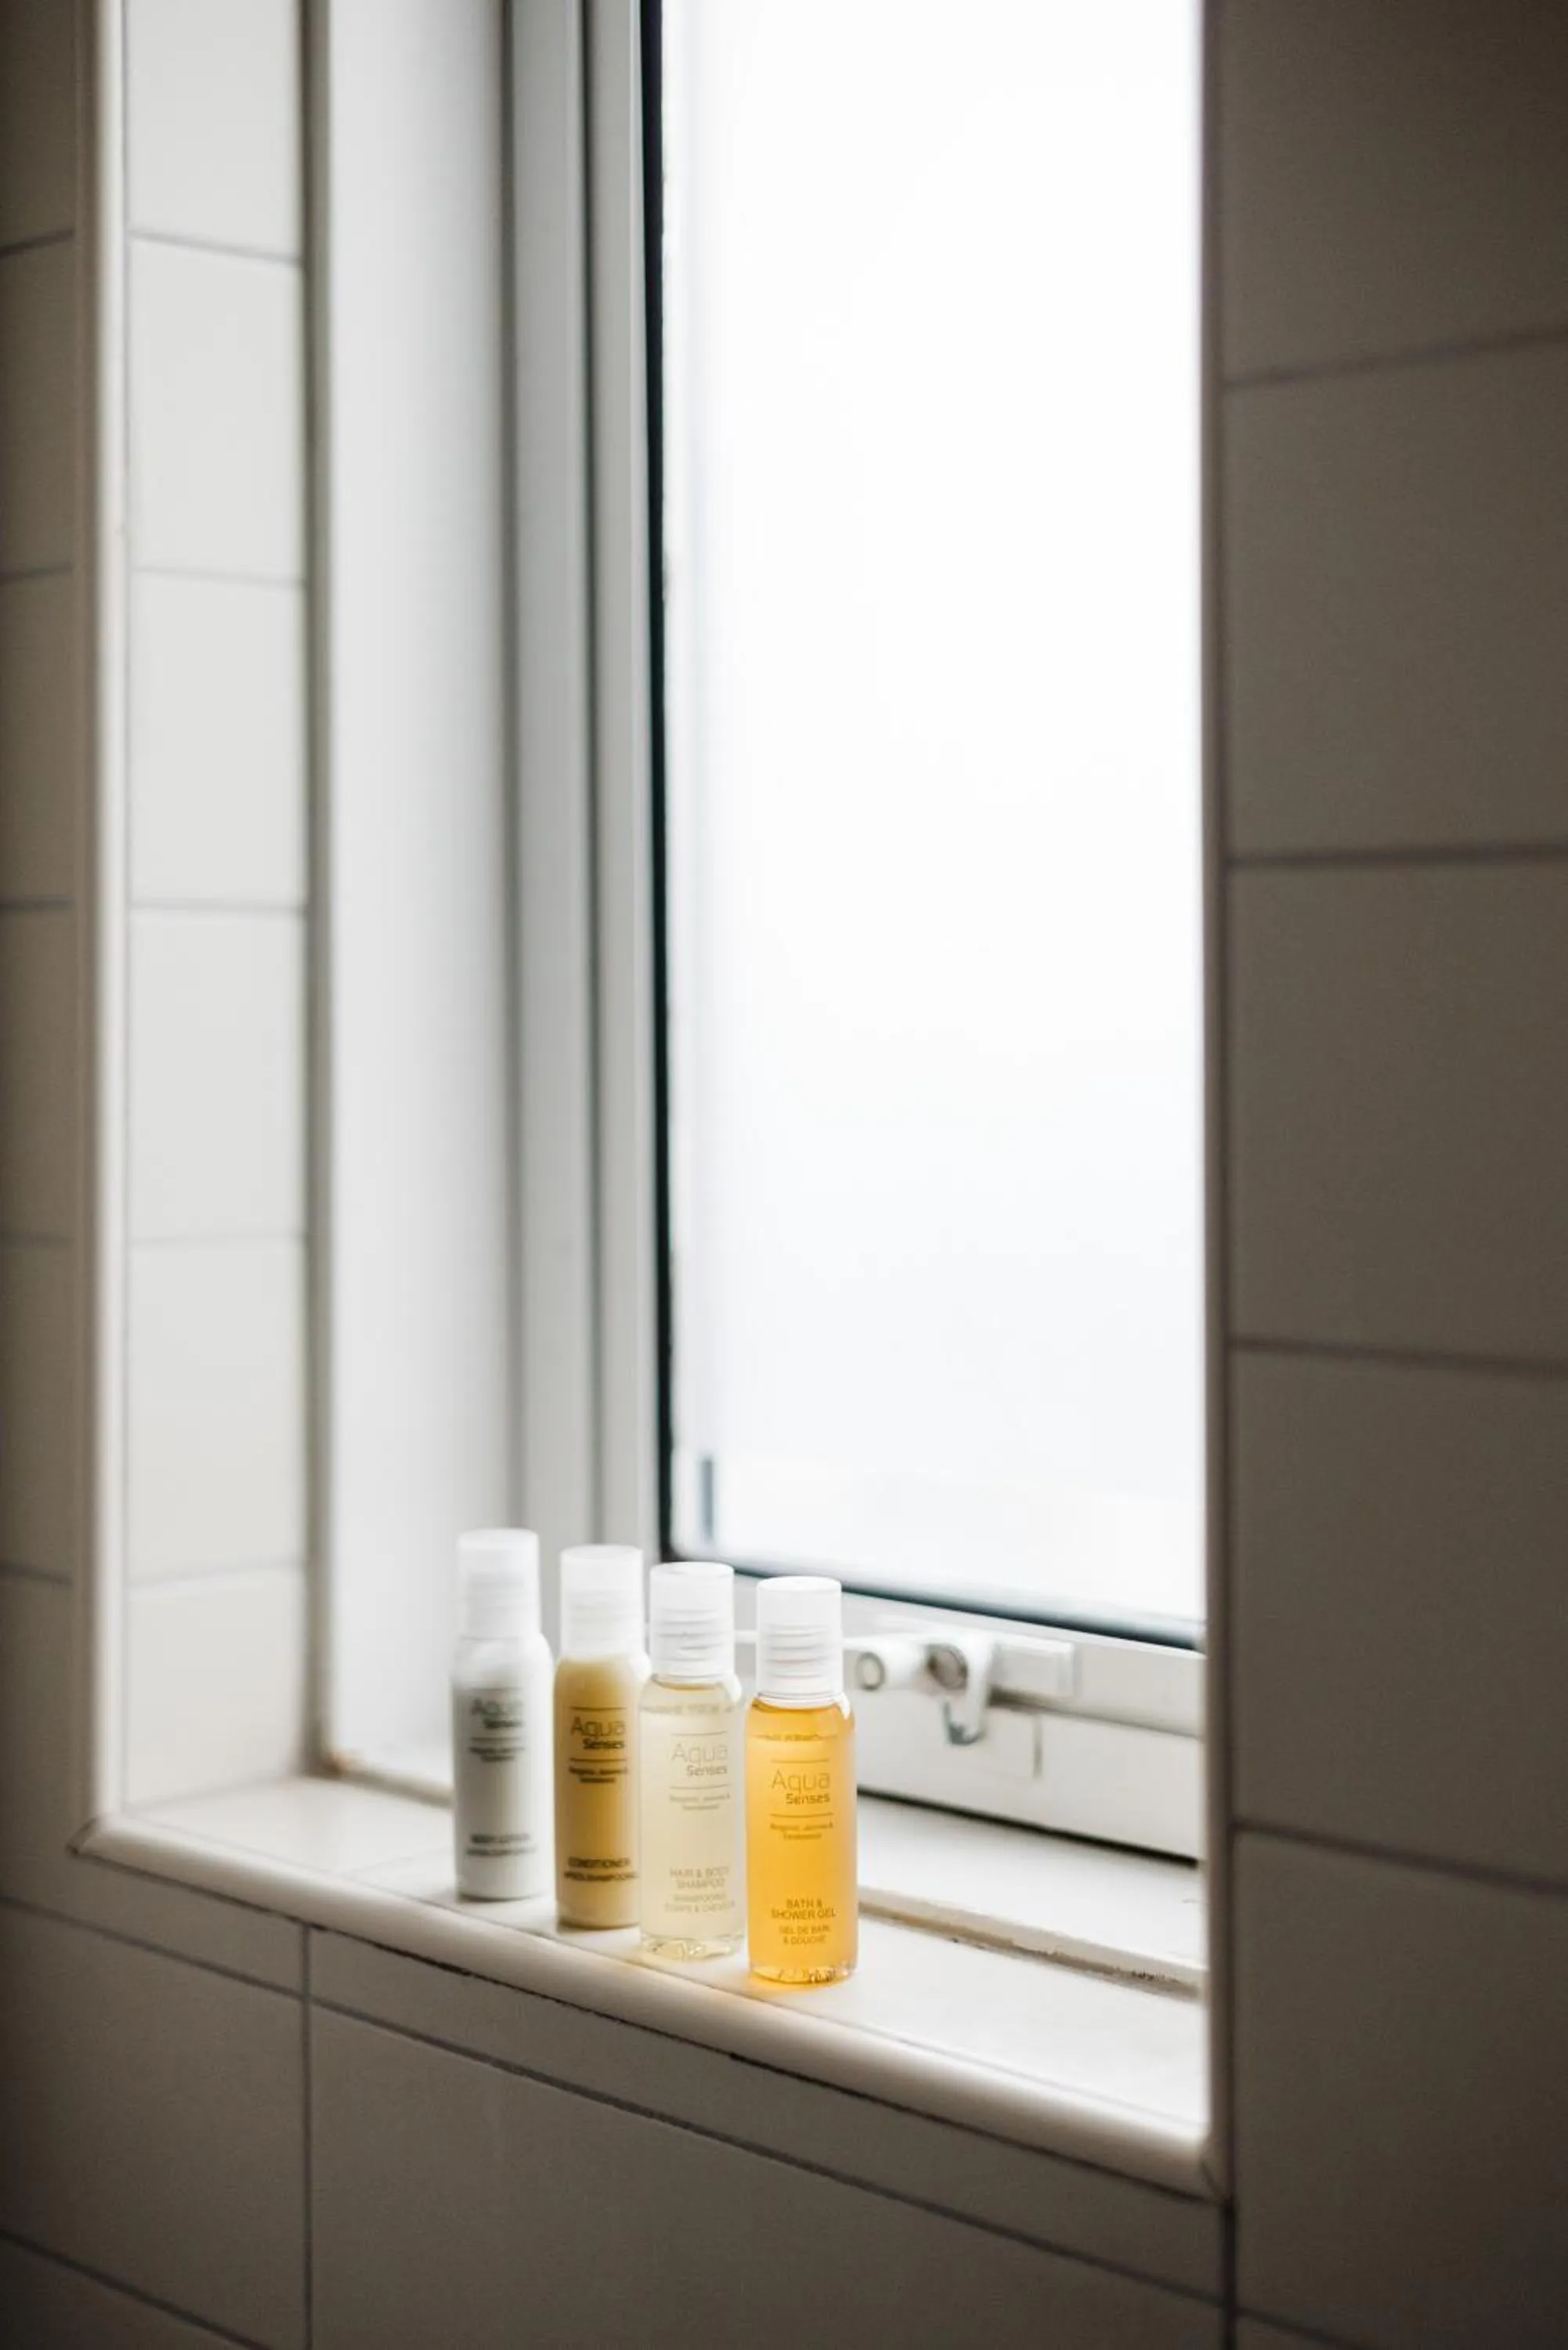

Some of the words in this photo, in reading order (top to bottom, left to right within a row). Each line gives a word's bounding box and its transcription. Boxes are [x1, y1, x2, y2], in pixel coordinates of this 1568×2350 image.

[571, 1716, 626, 1740] Aqua
[672, 1743, 728, 1768] Aqua
[686, 1765, 728, 1777] Senses
[771, 1769, 830, 1795] Aqua
[786, 1793, 830, 1805] Senses
[786, 1898, 814, 1909] BATH
[816, 1898, 823, 1908] &
[771, 1908, 815, 1919] SHOWER
[817, 1907, 837, 1918] GEL
